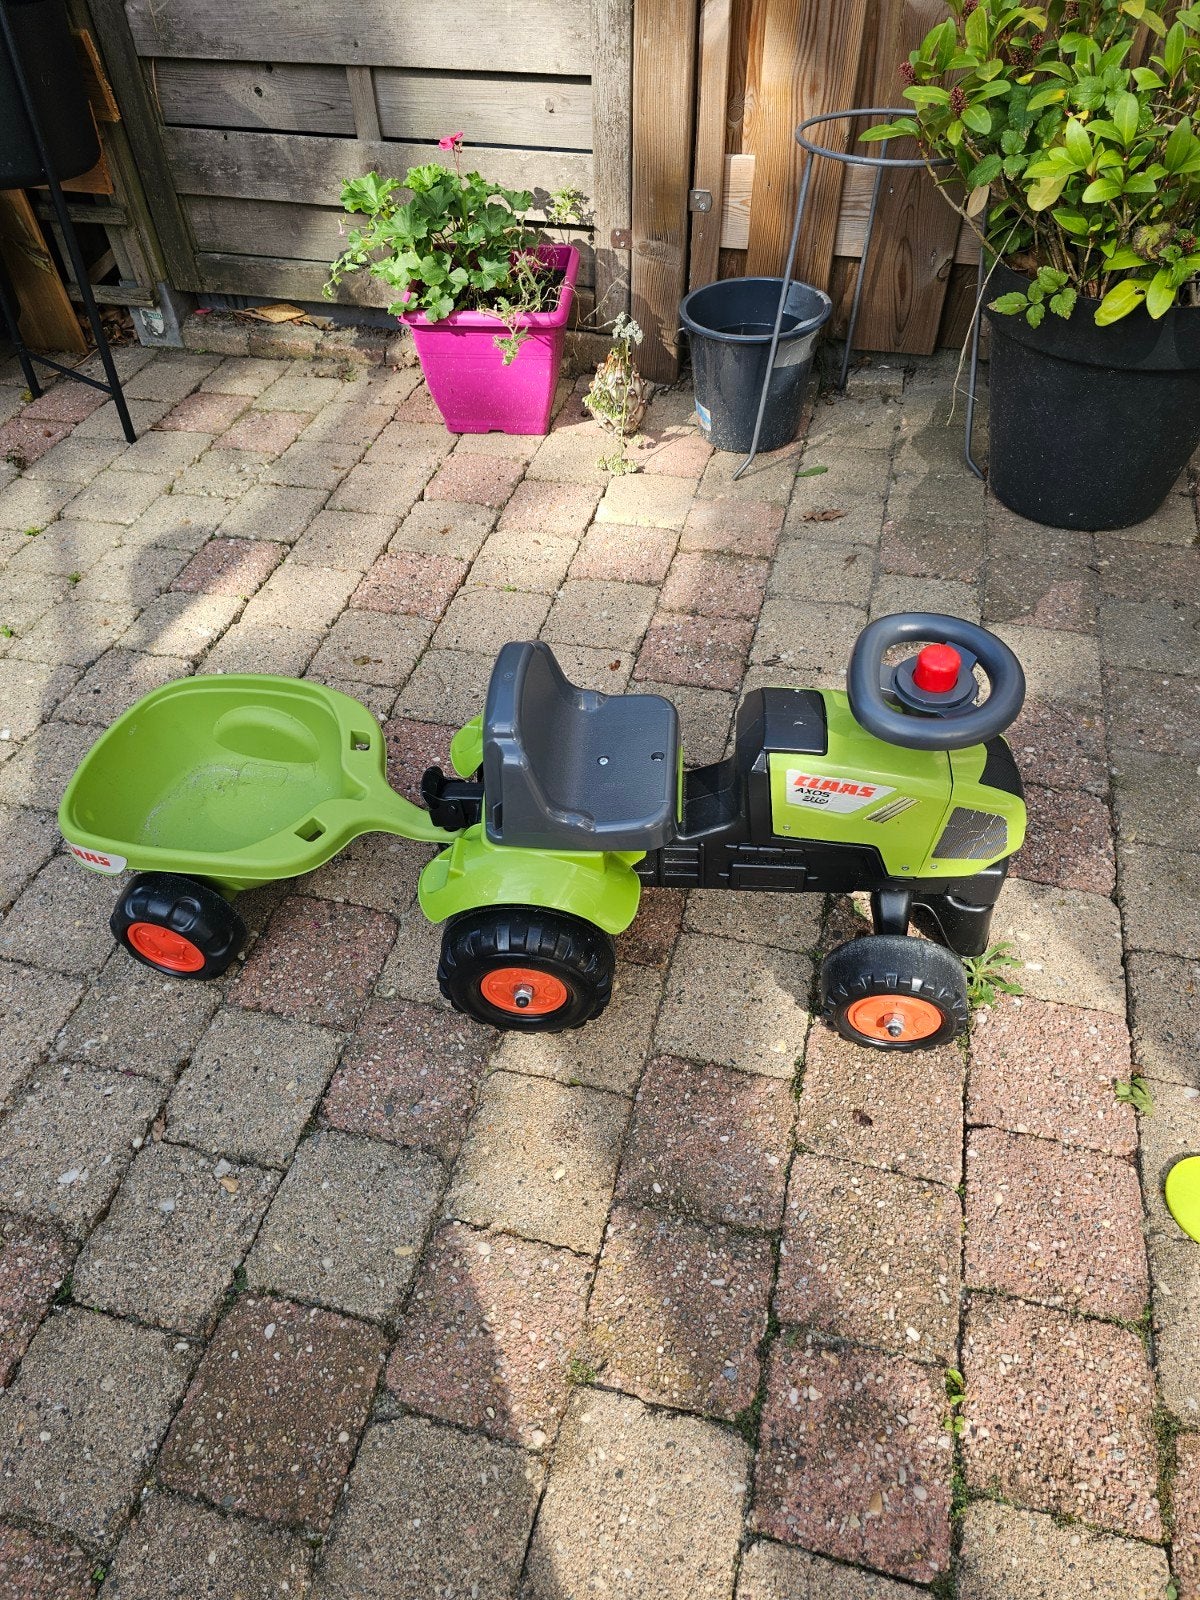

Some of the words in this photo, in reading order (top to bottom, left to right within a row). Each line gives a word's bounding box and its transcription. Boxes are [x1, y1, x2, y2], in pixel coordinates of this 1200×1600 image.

[793, 775, 877, 798] CLAAS
[795, 787, 831, 798] AXOS
[71, 846, 111, 867] AAS
